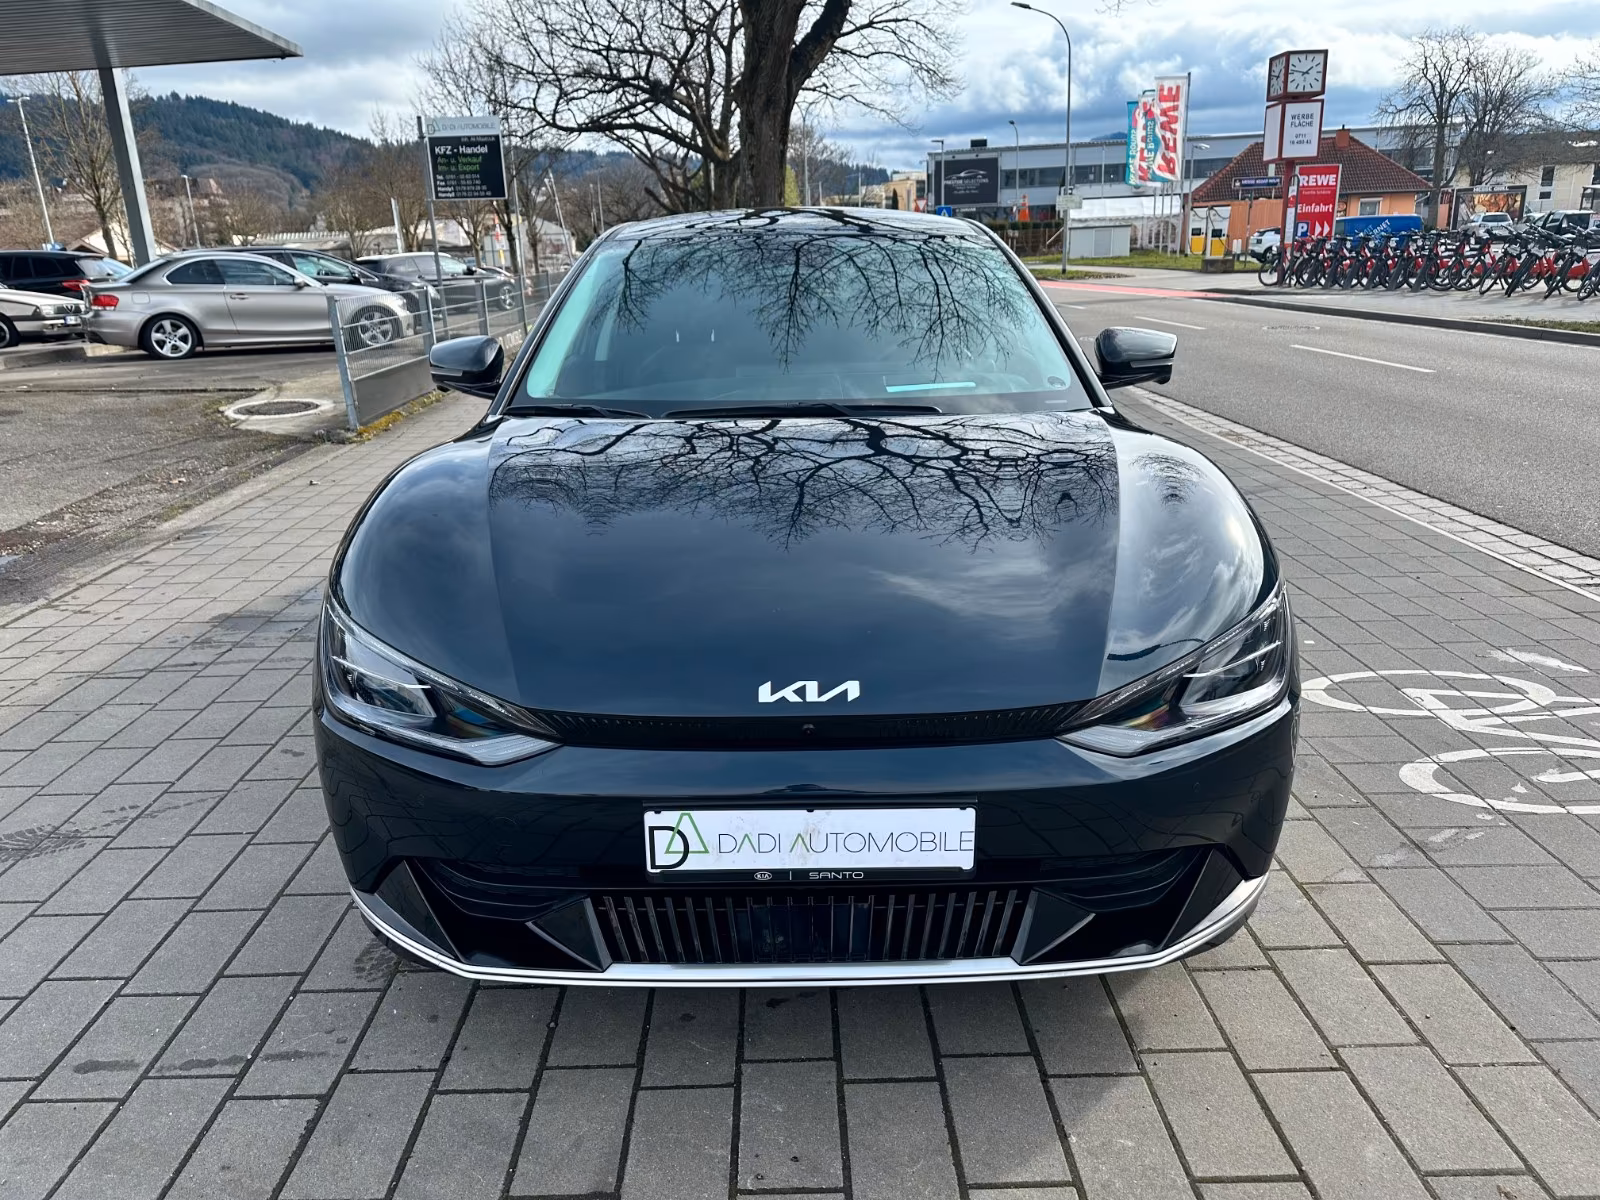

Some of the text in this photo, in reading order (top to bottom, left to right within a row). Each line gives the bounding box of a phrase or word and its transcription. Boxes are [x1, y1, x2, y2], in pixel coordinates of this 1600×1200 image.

[1157, 84, 1180, 176] REWE
[434, 146, 452, 154] KFZ
[459, 145, 488, 153] Handel
[458, 164, 480, 172] Export
[1299, 174, 1337, 186] REWE
[1297, 203, 1333, 213] Einfahrt
[1297, 222, 1308, 237] P
[759, 680, 860, 702] KIA
[718, 830, 974, 854] DADI AUTOMOBILE
[809, 871, 865, 880] SANTO
